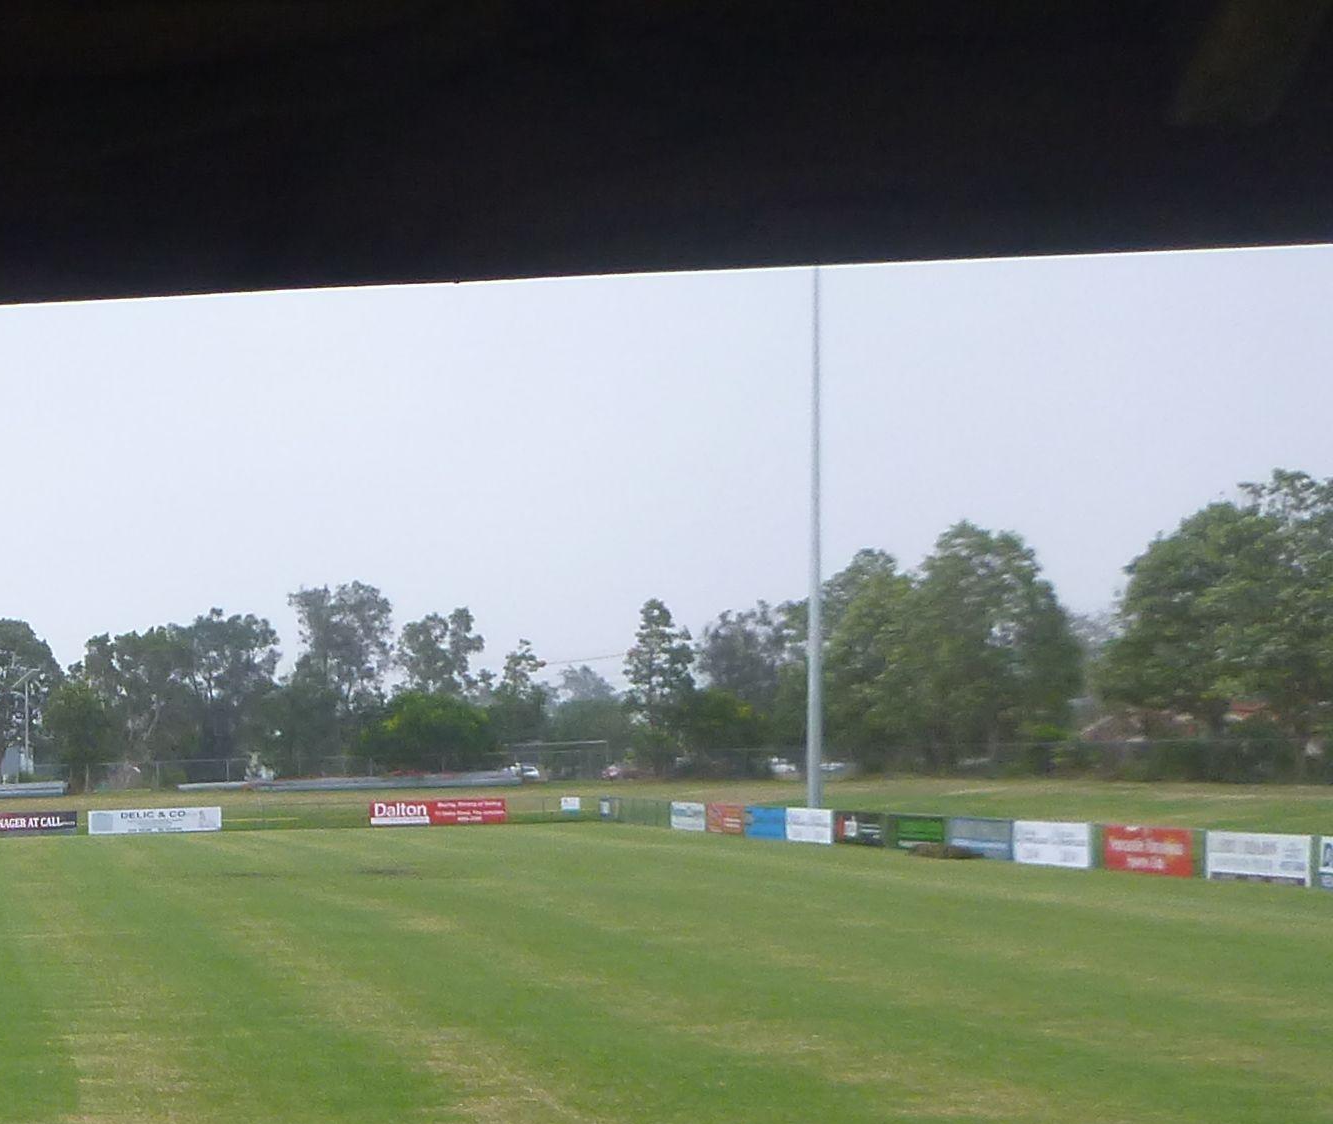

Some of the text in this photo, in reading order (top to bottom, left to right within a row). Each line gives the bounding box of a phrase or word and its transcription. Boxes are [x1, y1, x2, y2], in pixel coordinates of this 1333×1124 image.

[120, 811, 155, 819] DELIC
[169, 810, 186, 818] CO
[374, 803, 427, 817] Dalton
[28, 817, 39, 828] AT
[40, 816, 61, 827] CALL
